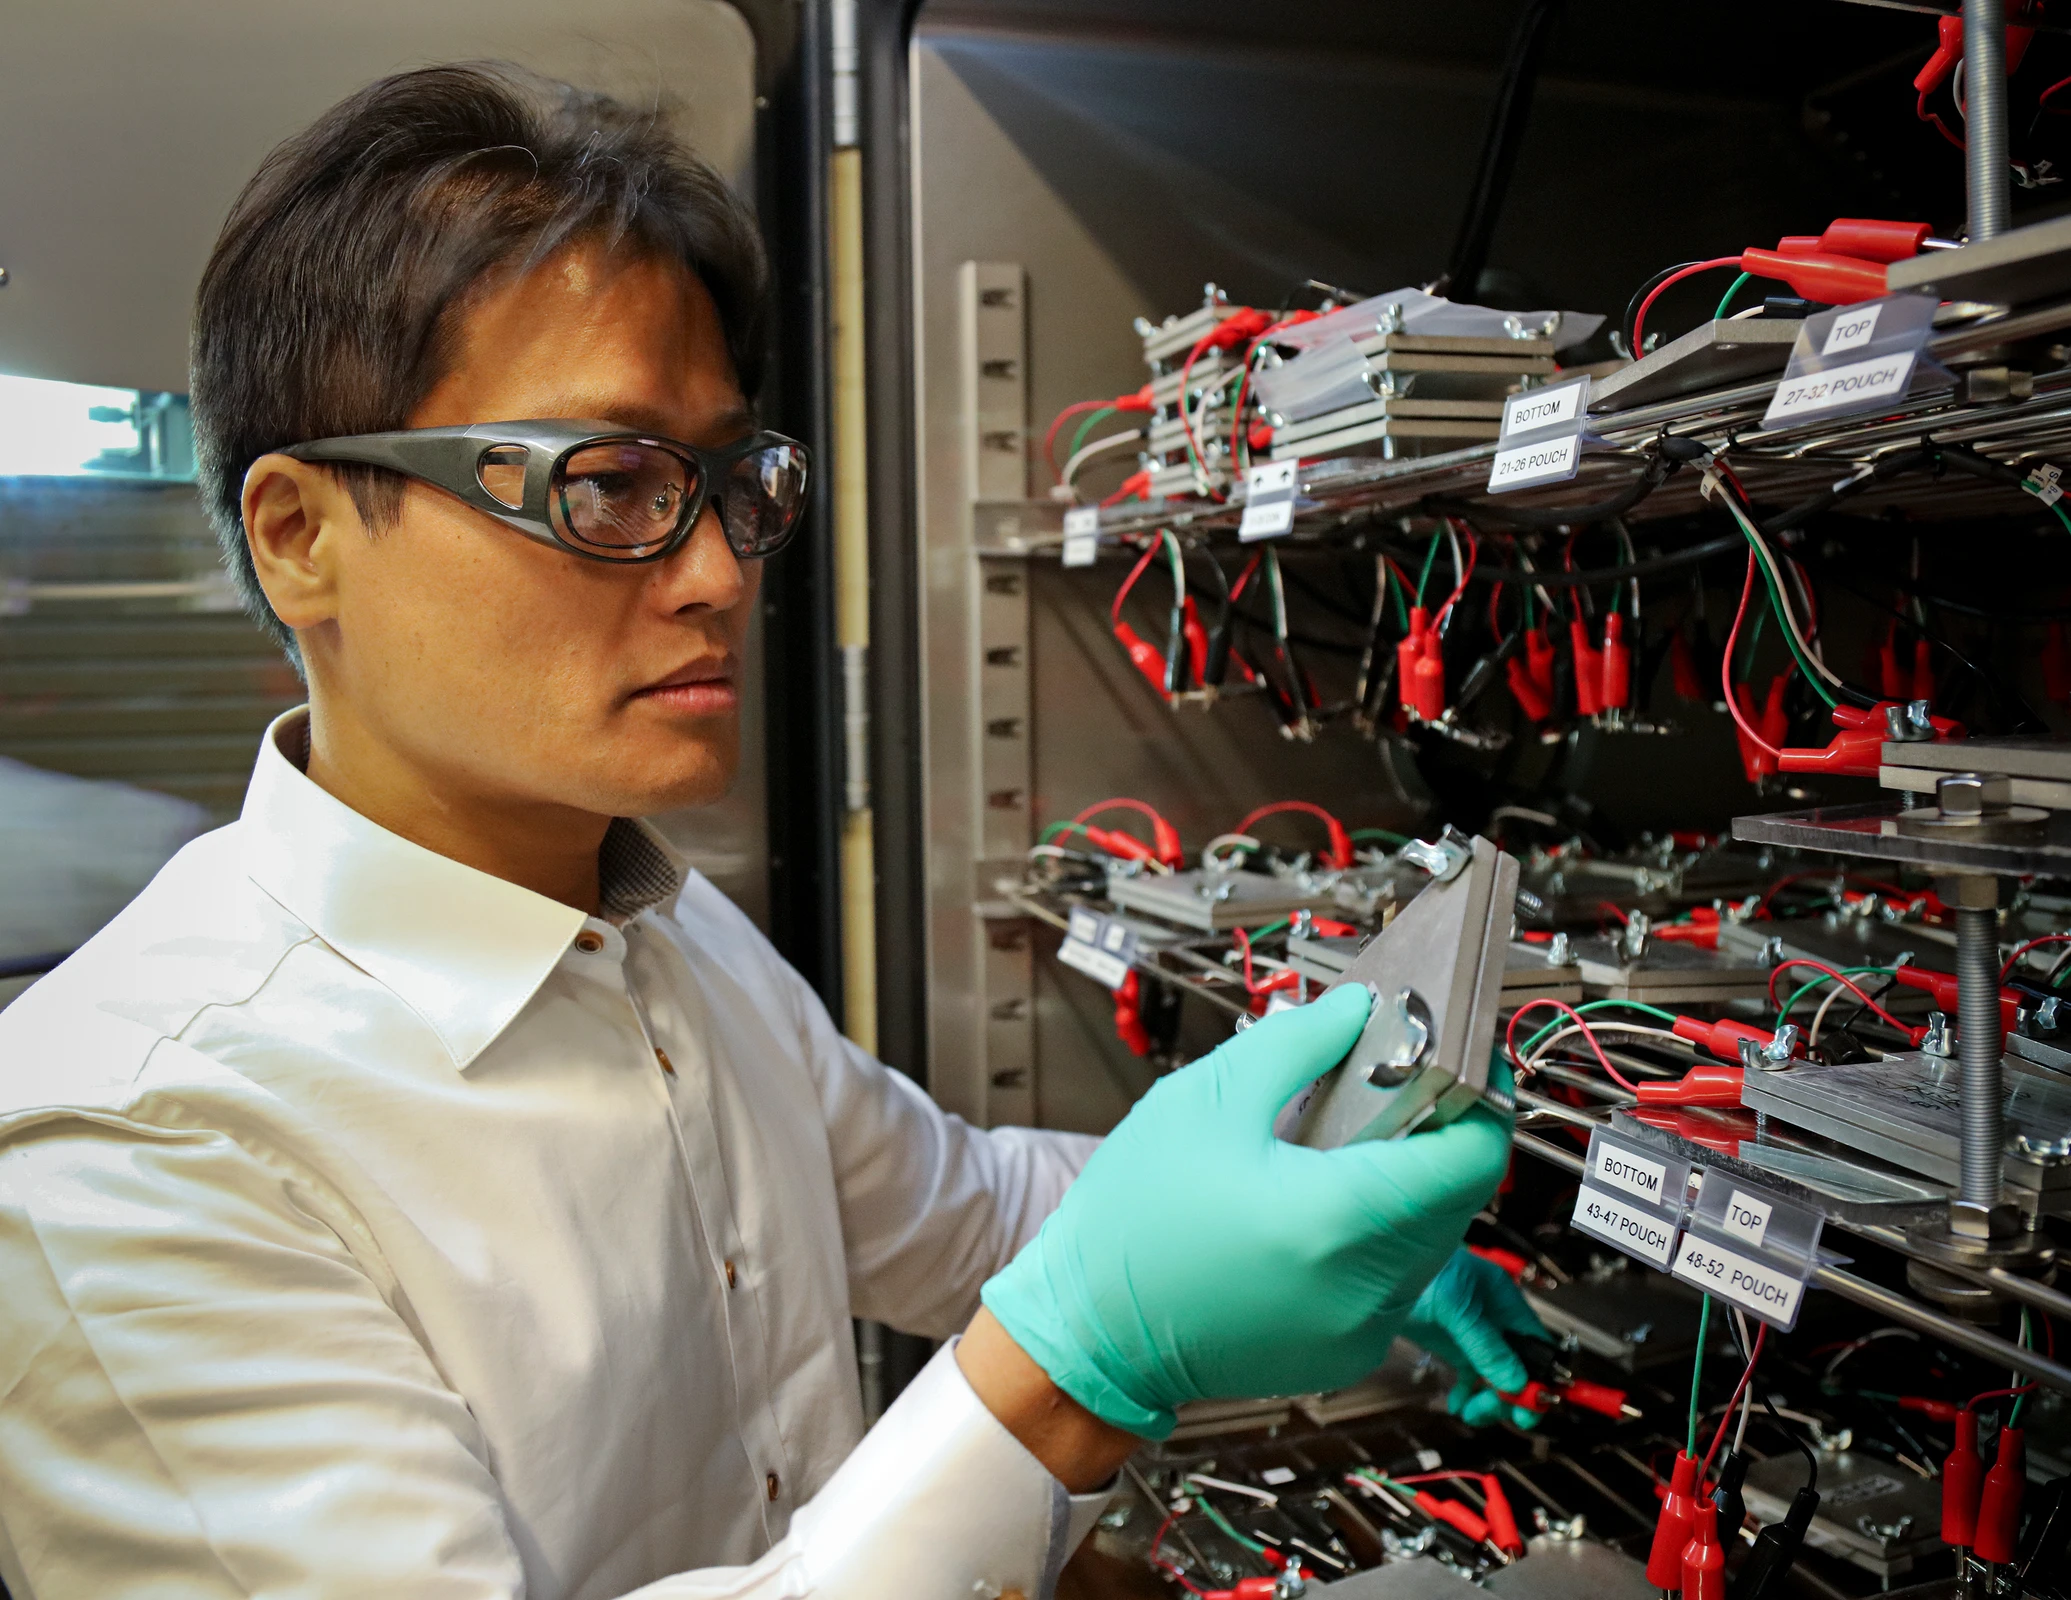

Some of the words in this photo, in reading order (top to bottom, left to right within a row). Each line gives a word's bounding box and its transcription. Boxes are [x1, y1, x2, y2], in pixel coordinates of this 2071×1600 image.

[1834, 319, 1872, 342] TOP
[1783, 383, 1828, 407] 27-32
[1829, 367, 1899, 396] POUCH
[1515, 400, 1561, 424] BOTTOM
[1499, 458, 1526, 475] 21-26
[1528, 448, 1568, 469] POUCH
[1604, 1157, 1659, 1192] BOTTOM
[1586, 1202, 1618, 1226] 43-47
[1619, 1216, 1667, 1252] POUCH
[1731, 1204, 1763, 1230] TOP
[1686, 1250, 1725, 1280] 48-52
[1730, 1269, 1790, 1308] POUCH
